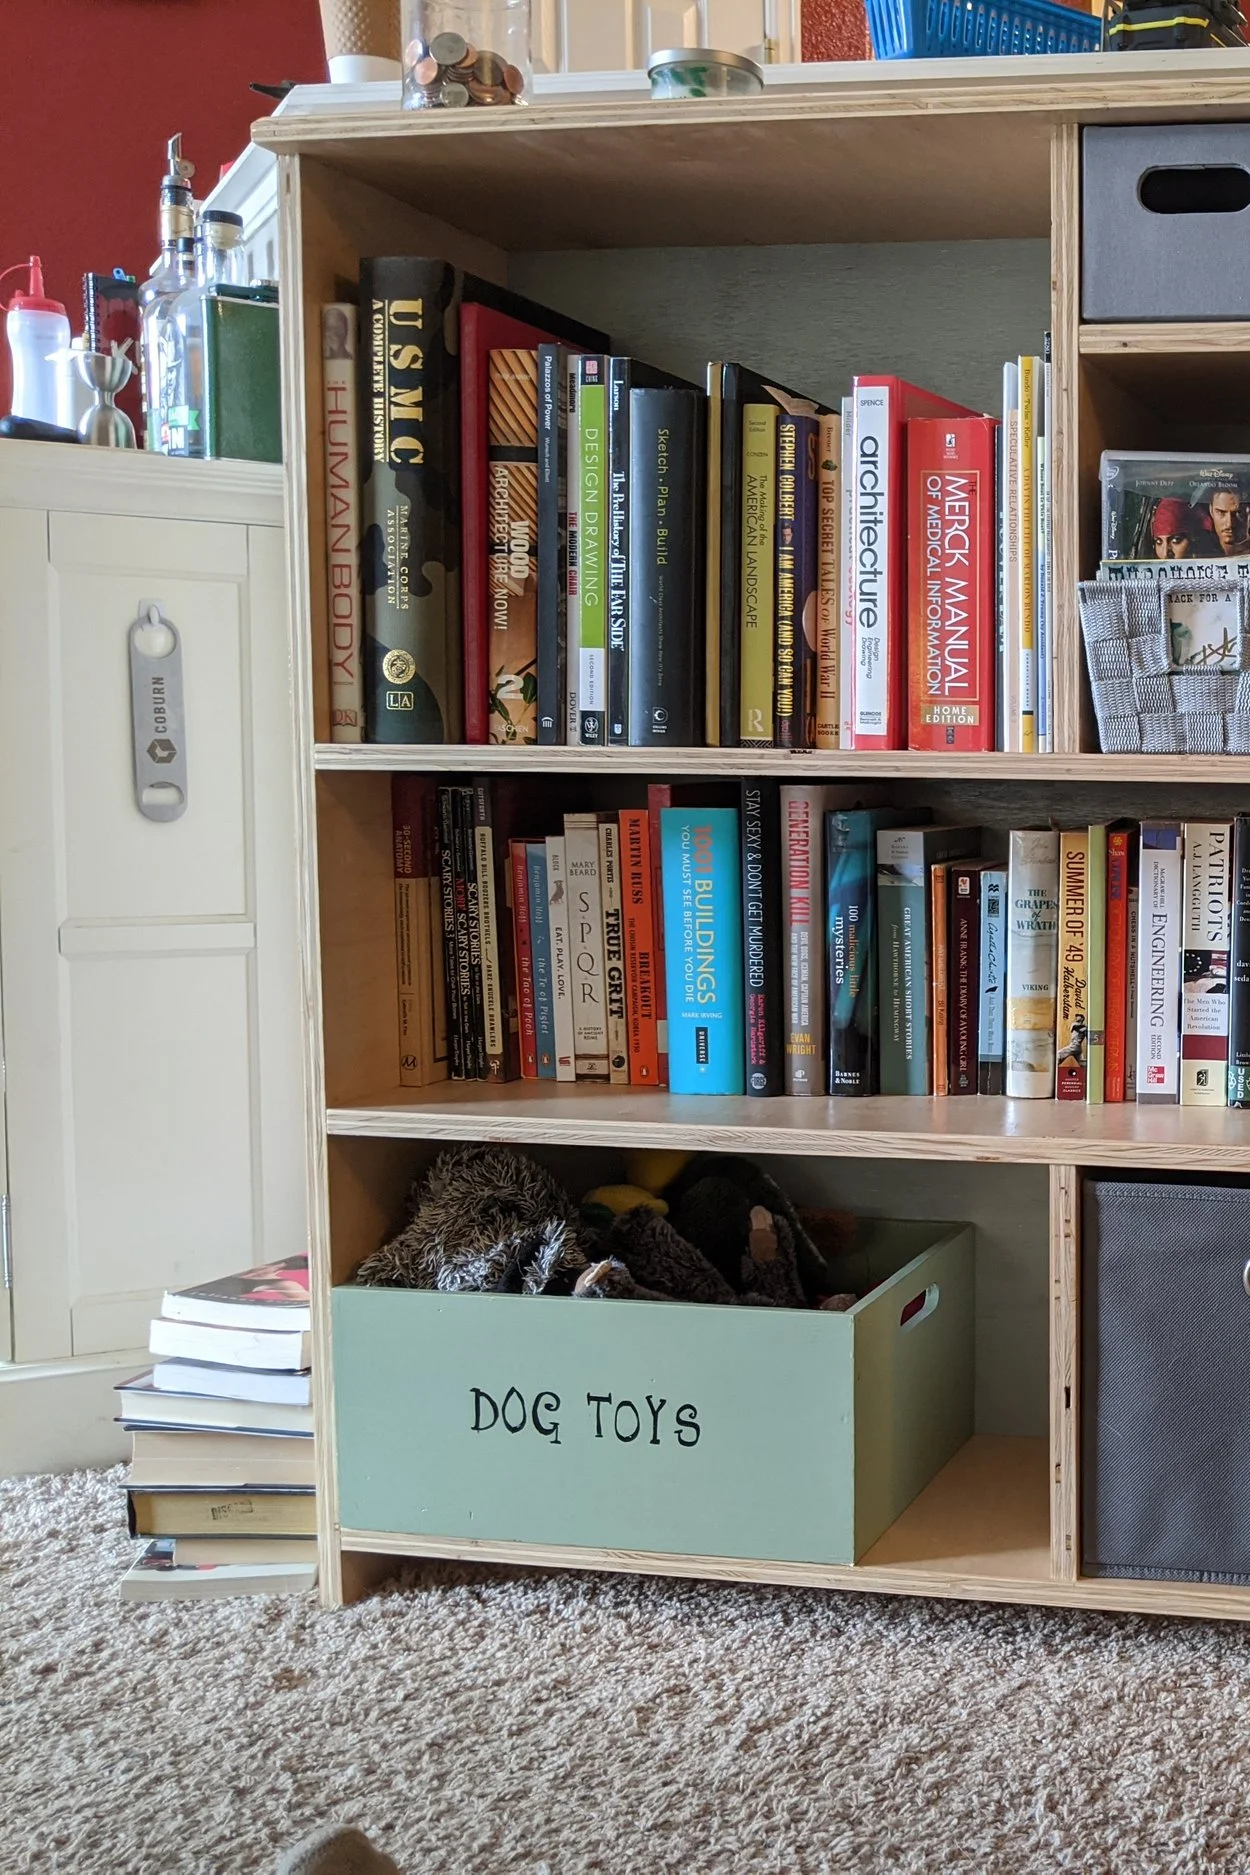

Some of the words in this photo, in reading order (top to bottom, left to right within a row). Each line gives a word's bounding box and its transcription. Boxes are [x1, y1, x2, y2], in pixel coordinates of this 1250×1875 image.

[373, 299, 384, 310] A
[373, 313, 384, 392] COMPLETE
[543, 356, 552, 392] Palazzos
[614, 380, 623, 411] Larson
[373, 398, 385, 462] HISTORY
[543, 404, 552, 430] Power
[585, 428, 599, 504] DESIGN
[657, 428, 669, 474] Sketch
[779, 424, 796, 470] STEPHEN
[1009, 421, 1017, 485] SPECULATIVE
[327, 385, 351, 555] HUMAN
[927, 476, 941, 499] OF
[657, 486, 670, 516] Plan
[746, 475, 758, 546] AMERICAN
[779, 475, 796, 521] COLBERT
[822, 480, 835, 505] TOP
[494, 467, 509, 583] ARCHITECTURE
[569, 512, 577, 527] THE
[821, 507, 835, 554] SECRET
[859, 435, 885, 628] architecture
[926, 504, 941, 576] MEDICAL
[944, 475, 970, 567] MERCK
[1009, 489, 1017, 562] RELATIONSHIPS
[510, 520, 529, 578] WOOD
[569, 530, 577, 567] MODERN
[585, 512, 599, 606] DRAWING
[656, 528, 669, 565] Build
[778, 553, 792, 569] AM
[569, 570, 577, 595] CHAIR
[746, 551, 758, 628] LANDSCAPE
[778, 573, 792, 616] AMERICA
[821, 559, 835, 607] TALES
[332, 564, 354, 679] BODY
[494, 589, 508, 629] NOW!
[822, 609, 834, 625] OF
[777, 620, 792, 645] (AND
[821, 628, 835, 663] World
[926, 580, 941, 695] INFORMATION
[944, 577, 969, 695] MANUAL
[778, 665, 792, 685] CAN
[779, 649, 792, 663] SO
[865, 637, 874, 679] Engineering
[821, 666, 835, 688] War
[821, 691, 835, 699] II
[152, 677, 167, 734] COBURN
[776, 689, 792, 717] YOU!)
[925, 715, 975, 724] EDITION
[933, 706, 968, 714] HOME
[746, 790, 761, 817] STAY
[628, 818, 641, 869] MARTIN
[680, 825, 689, 850] YOU
[694, 824, 714, 874] 1001
[746, 820, 763, 849] SEXY
[787, 800, 811, 889] GENERATION
[681, 853, 691, 884] MUST
[747, 852, 761, 860] &
[467, 883, 480, 917] SCARY
[631, 871, 643, 904] RUSS
[682, 889, 692, 907] SEE
[747, 864, 762, 898] DON'T
[1066, 851, 1086, 916] SUMMER
[1206, 831, 1225, 942] PATRIOTS
[683, 911, 693, 953] BEFORE
[748, 901, 763, 922] GET
[788, 896, 810, 927] KILL
[903, 907, 912, 937] GREAT
[1065, 919, 1084, 938] OF
[468, 919, 481, 964] STORIES
[605, 908, 621, 960] TRUE
[694, 879, 716, 1004] BUILDINGS
[684, 956, 693, 982] YOU
[748, 925, 765, 987] MURDERED
[904, 940, 912, 987] AMERICAN
[1149, 913, 1168, 1028] ENGINEERING
[608, 967, 624, 1019] GRIT
[639, 952, 652, 1020] BREAKOUT
[684, 984, 694, 1003] DIE
[904, 990, 912, 1020] SHORT
[1061, 966, 1076, 1021] Halberstam
[1074, 977, 1086, 1009] David
[905, 1022, 913, 1060] STORIES
[470, 1386, 561, 1444] DOG
[586, 1392, 701, 1447] TOYS
